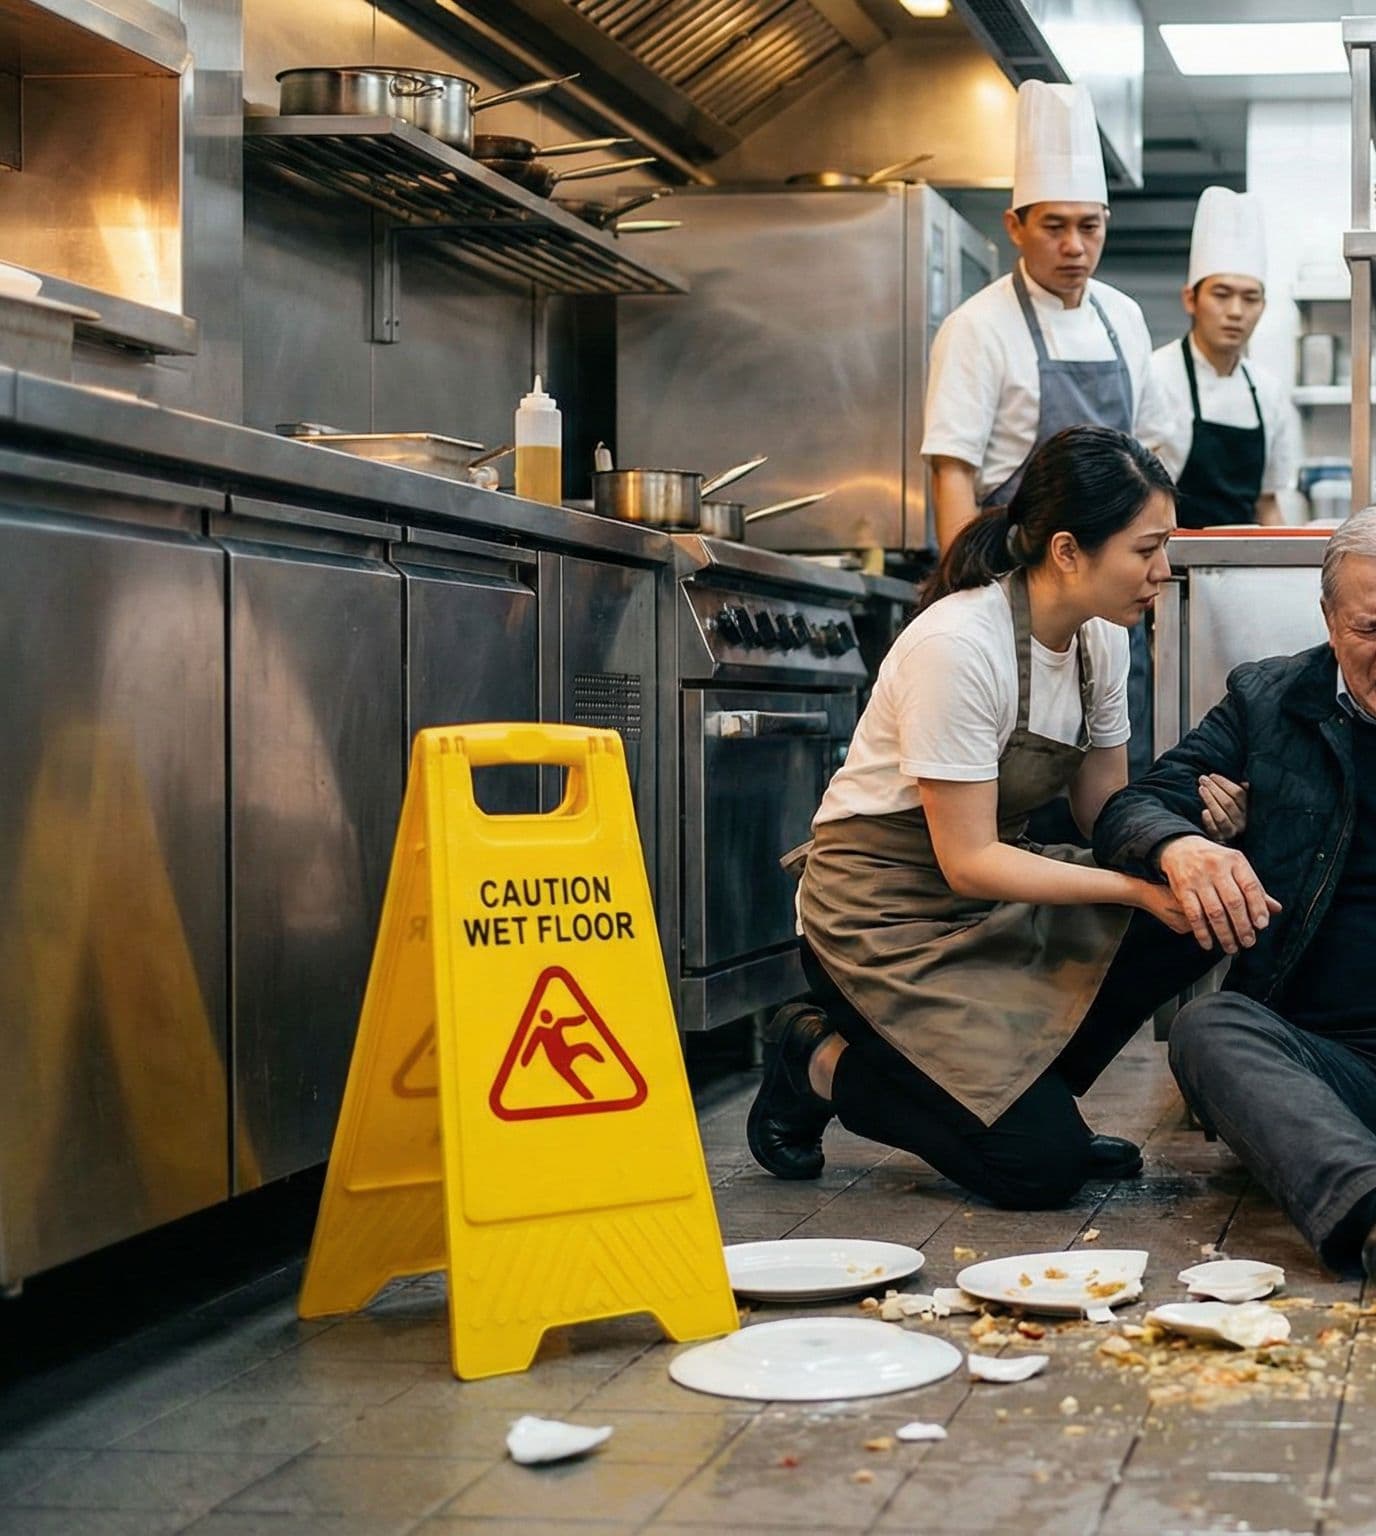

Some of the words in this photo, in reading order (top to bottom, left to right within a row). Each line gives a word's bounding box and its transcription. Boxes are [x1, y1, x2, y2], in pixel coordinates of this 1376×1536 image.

[480, 876, 611, 908] CAUTION
[463, 916, 528, 947] WET
[537, 912, 635, 943] FLOOR
